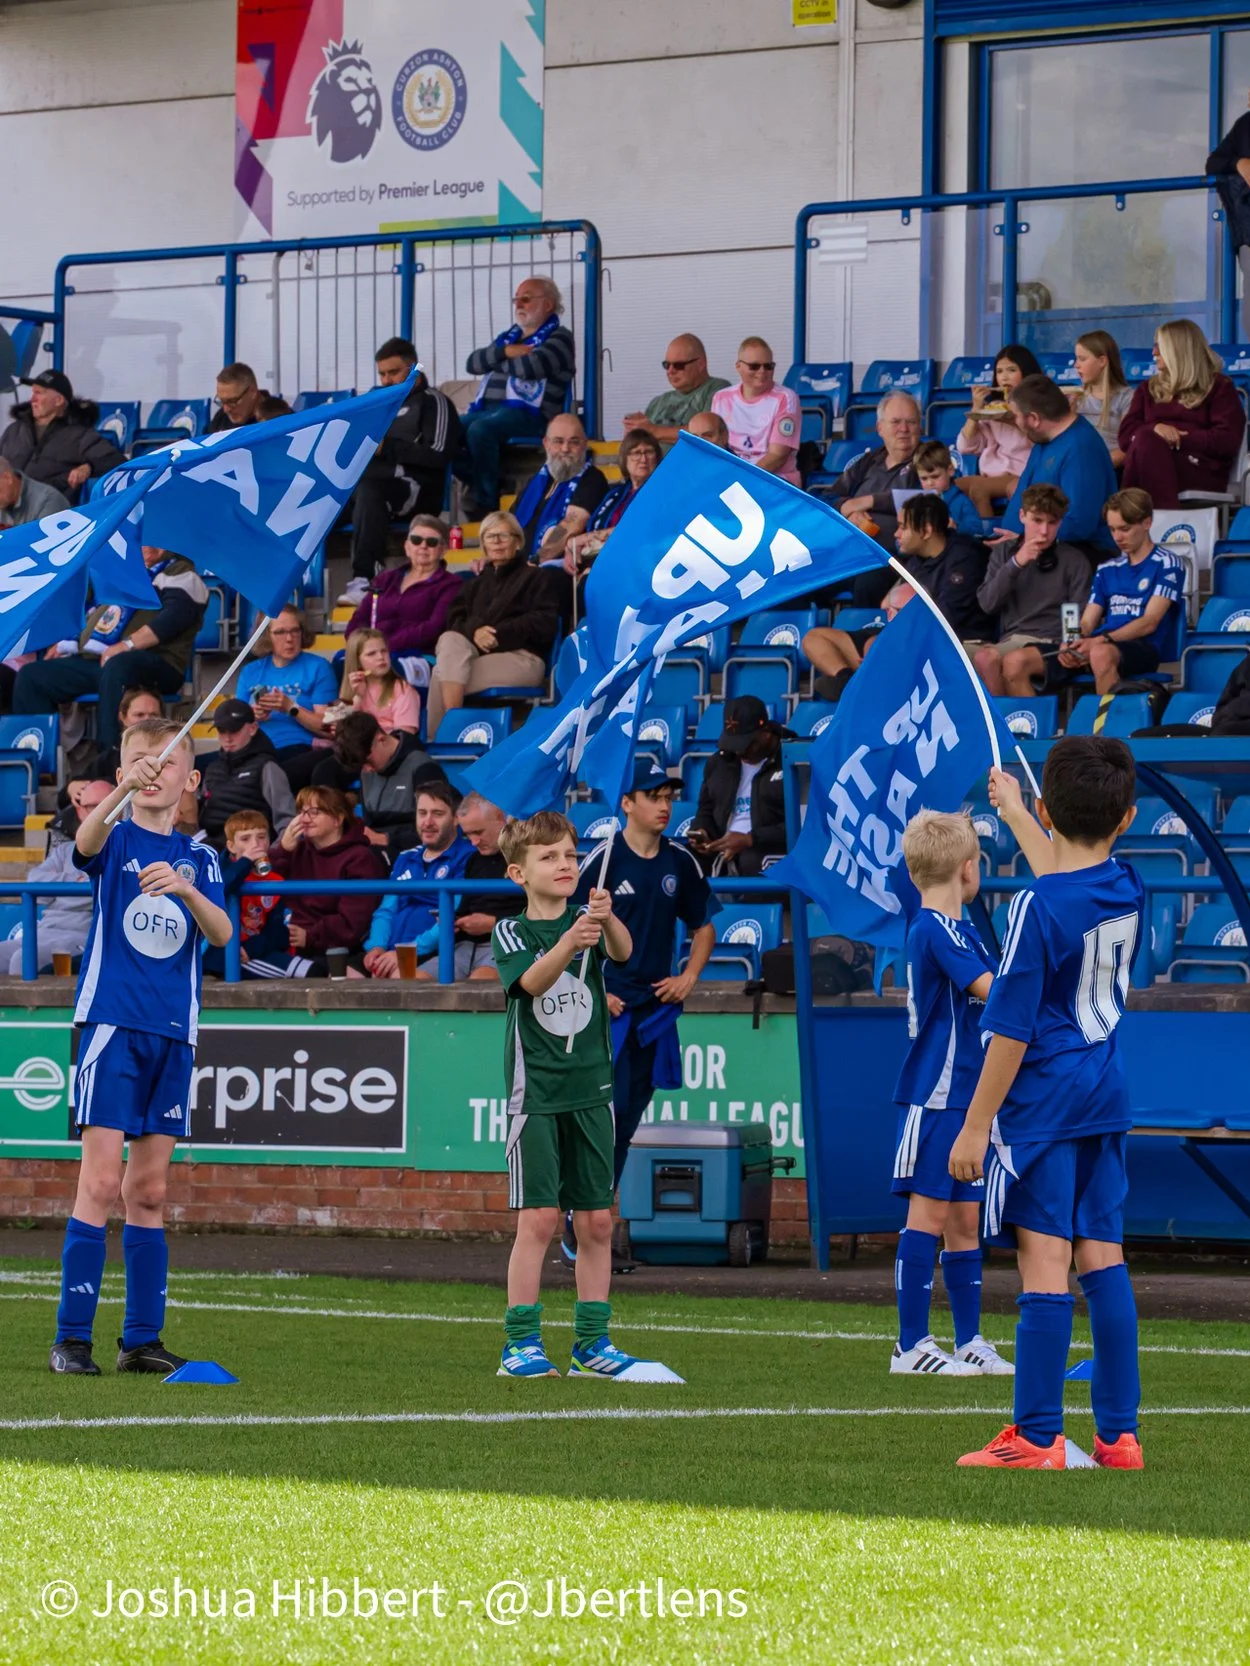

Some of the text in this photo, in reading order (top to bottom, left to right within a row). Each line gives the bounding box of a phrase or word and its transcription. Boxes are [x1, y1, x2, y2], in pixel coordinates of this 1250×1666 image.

[396, 52, 463, 91] CURZON ASHTON
[396, 112, 462, 147] FOOTBALL CLUB
[287, 179, 485, 209] Supported by Premier League
[133, 912, 178, 940] OFR
[1075, 911, 1138, 1045] 10
[8, 1050, 398, 1129] erprise
[469, 1098, 507, 1142] TH
